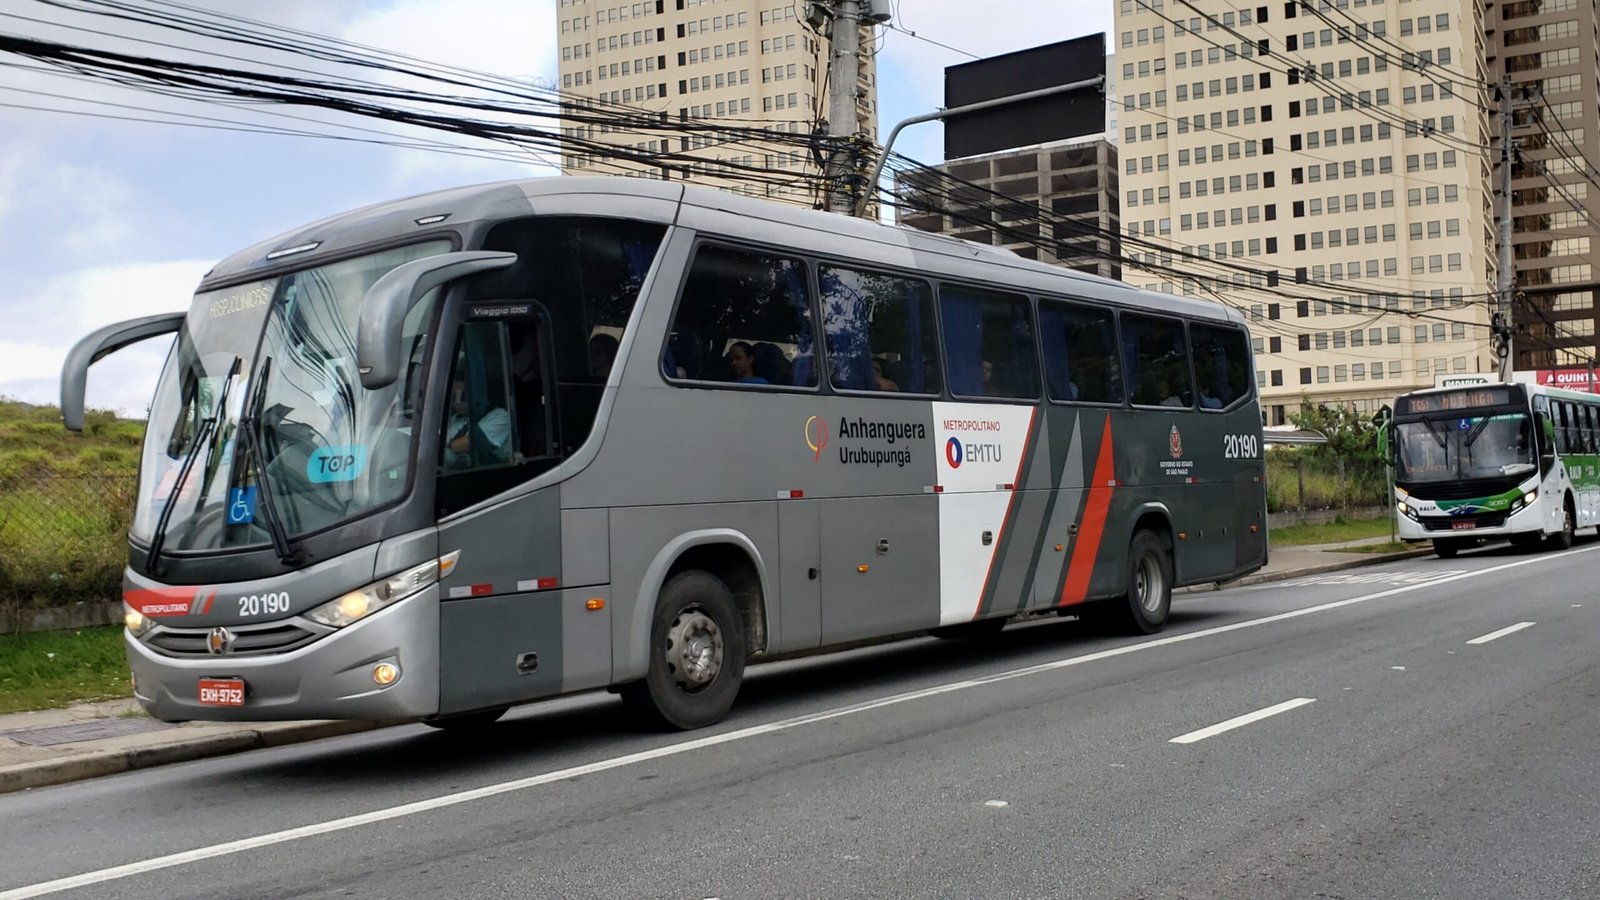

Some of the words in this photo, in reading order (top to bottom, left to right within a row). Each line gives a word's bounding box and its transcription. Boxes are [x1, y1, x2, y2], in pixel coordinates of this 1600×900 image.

[474, 308, 509, 317] Viaggio
[510, 306, 528, 314] 1050
[839, 416, 926, 444] Anhanguera
[943, 419, 1001, 432] METROPOLITANO
[965, 443, 1001, 462] EMTU
[1224, 434, 1258, 459] 20190
[318, 454, 355, 474] TOP
[839, 446, 911, 467] Urubupungá
[142, 603, 188, 613] METROPOLITANO
[238, 591, 290, 617] 20190
[201, 688, 242, 703] EKH-9752
